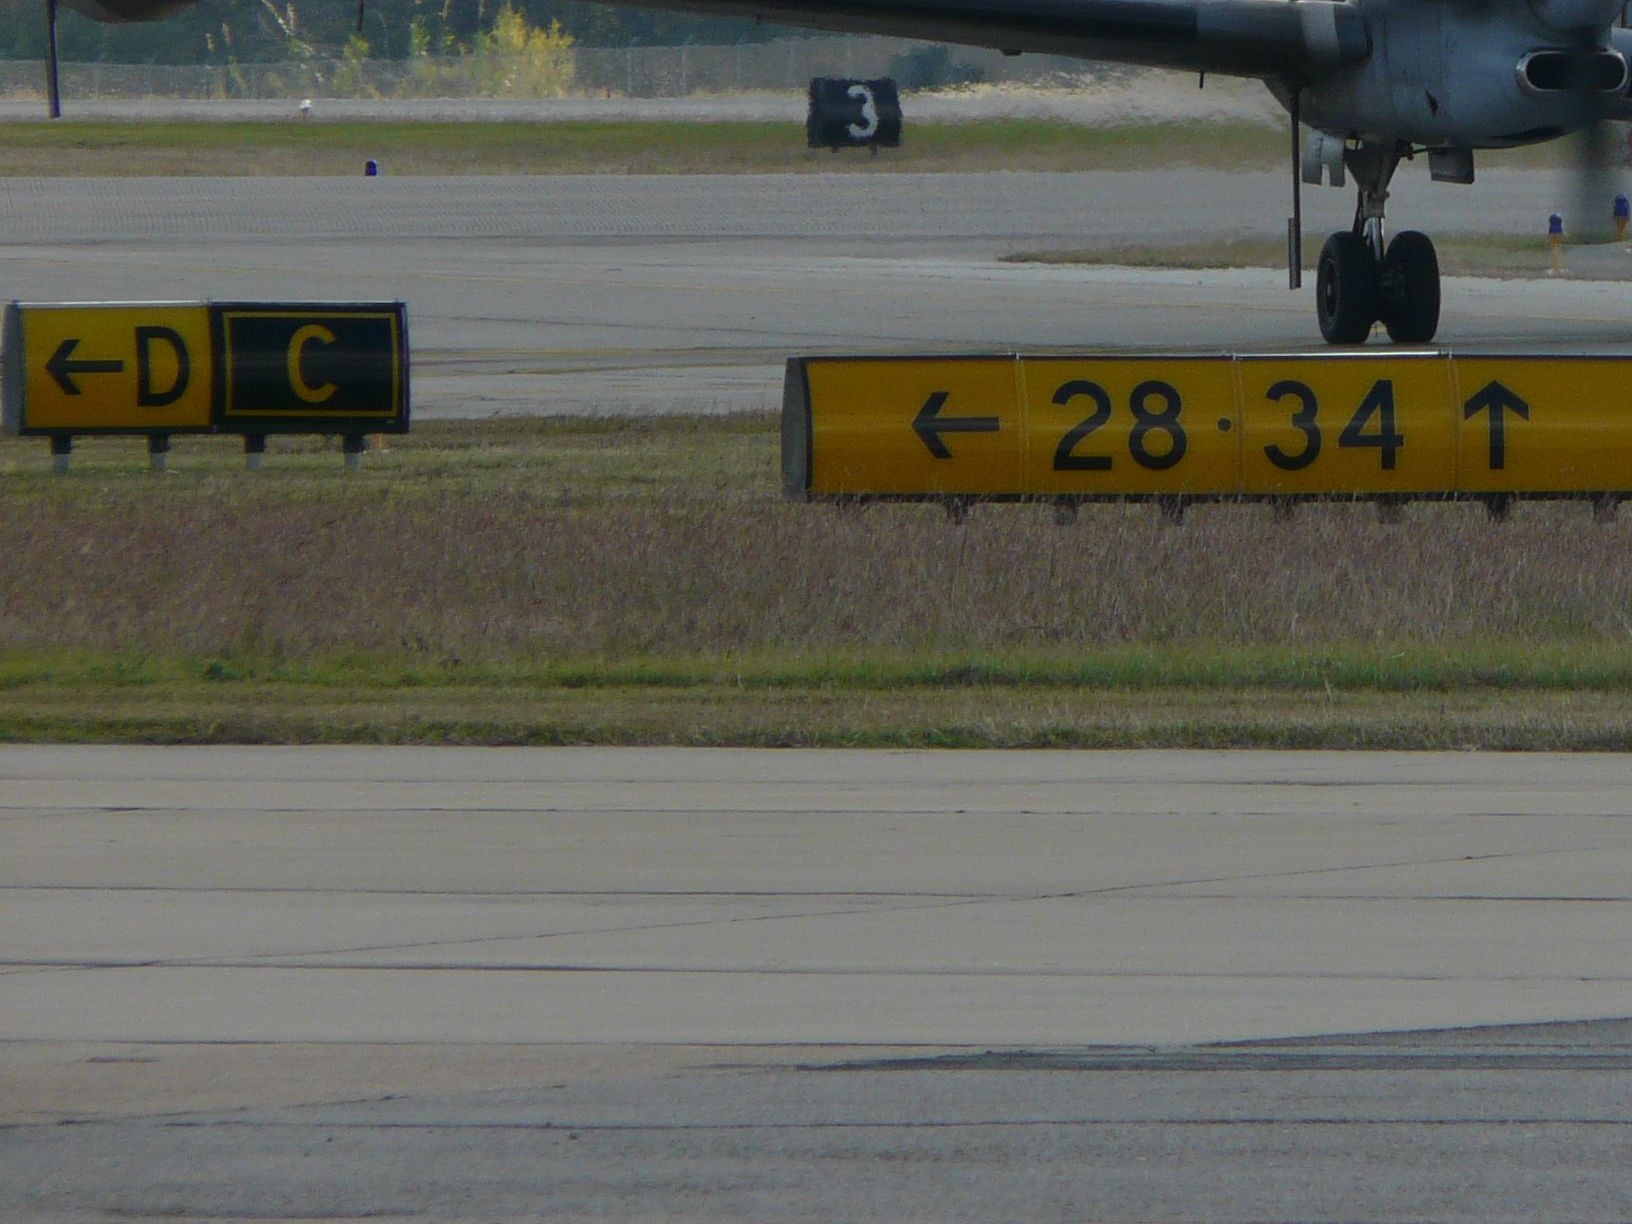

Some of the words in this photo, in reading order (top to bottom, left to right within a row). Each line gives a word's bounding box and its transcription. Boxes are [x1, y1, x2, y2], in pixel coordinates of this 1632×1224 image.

[847, 84, 878, 137] 3
[136, 326, 190, 407] D
[287, 324, 338, 404] C
